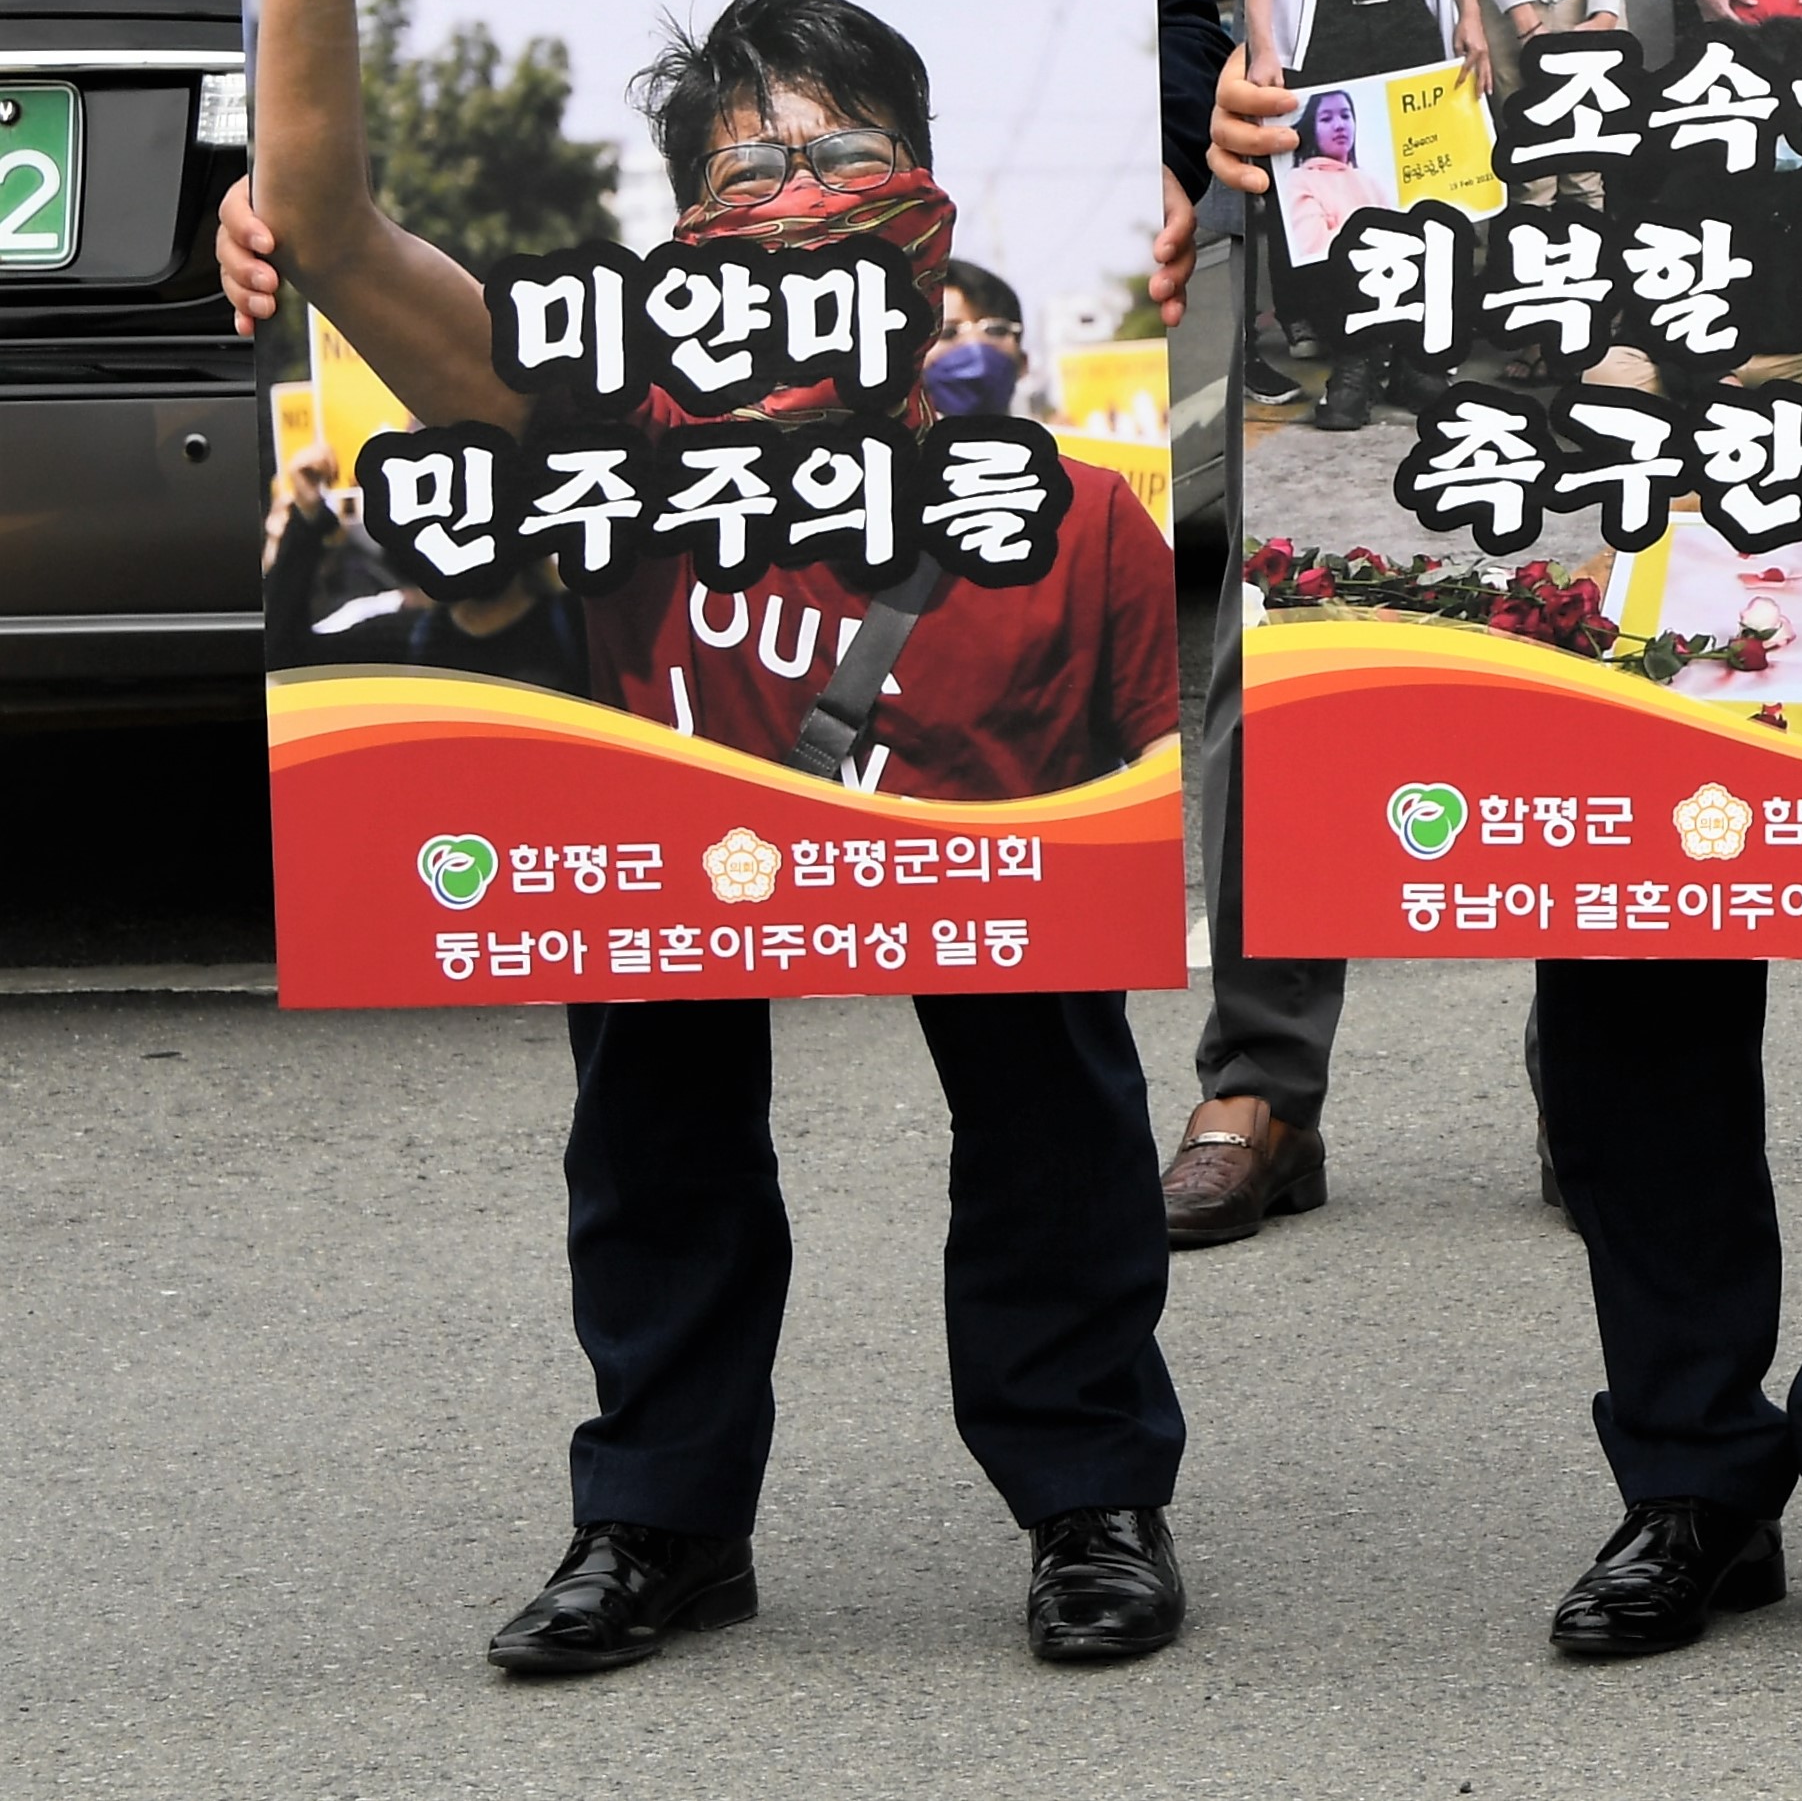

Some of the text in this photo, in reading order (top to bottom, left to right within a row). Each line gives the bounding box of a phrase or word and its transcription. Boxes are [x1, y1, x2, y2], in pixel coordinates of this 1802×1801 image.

[1402, 87, 1444, 113] R.I.P
[1344, 218, 1752, 355] 회복할
[511, 259, 906, 393] 미얀마
[382, 438, 1046, 575] 민주주의를
[1480, 796, 1632, 846] 함평군
[510, 844, 662, 893] 함평군
[792, 836, 1040, 886] 함평군의회
[1402, 884, 1553, 931] 동남아
[436, 920, 1028, 979] 동남아 결혼이주여성 일동
